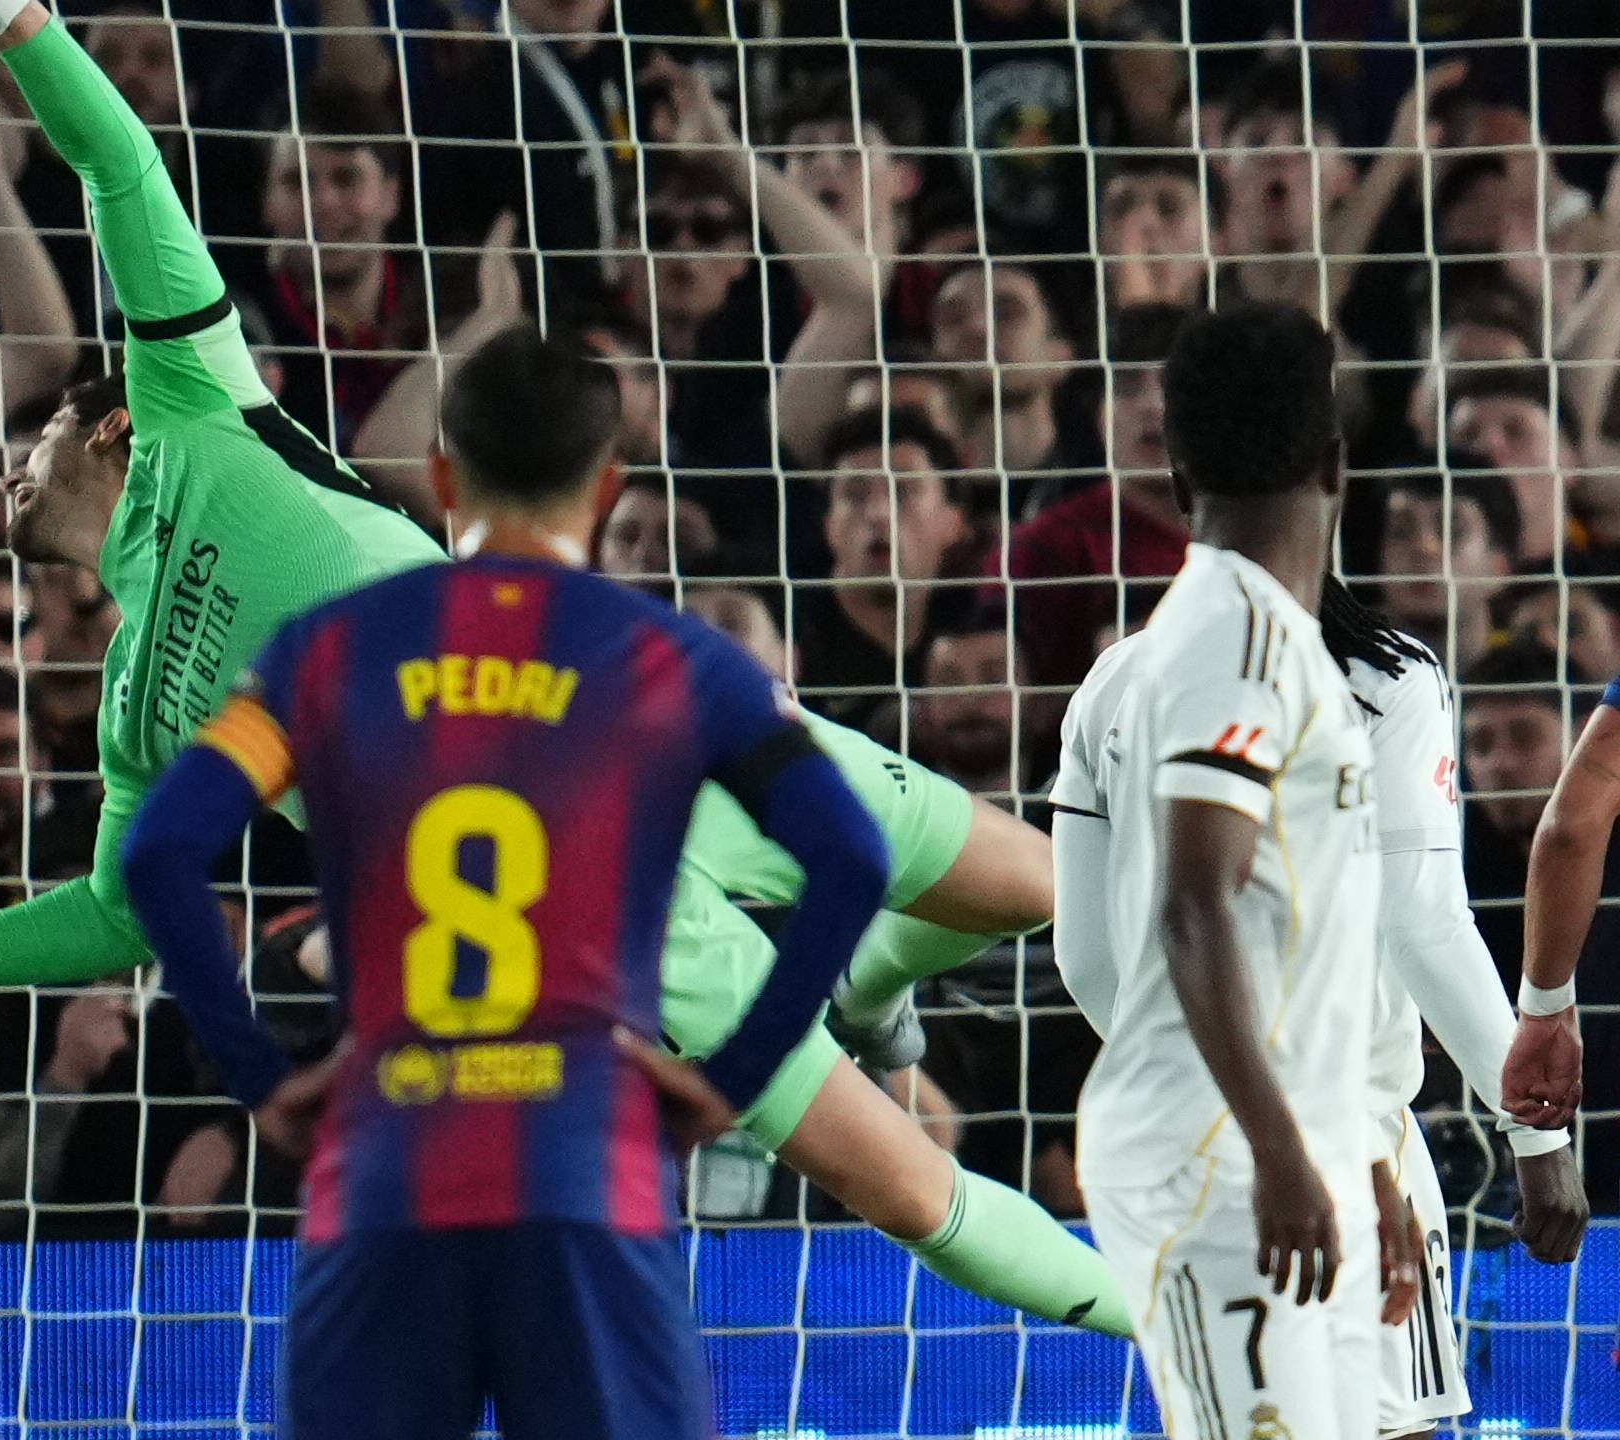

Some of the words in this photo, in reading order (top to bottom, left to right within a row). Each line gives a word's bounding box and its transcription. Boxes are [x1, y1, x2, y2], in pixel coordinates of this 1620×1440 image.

[154, 538, 220, 736] Emirates
[193, 584, 240, 685] BETTER
[396, 654, 580, 726] PEDRI
[402, 783, 549, 1038] 8
[1222, 1296, 1270, 1391] 7
